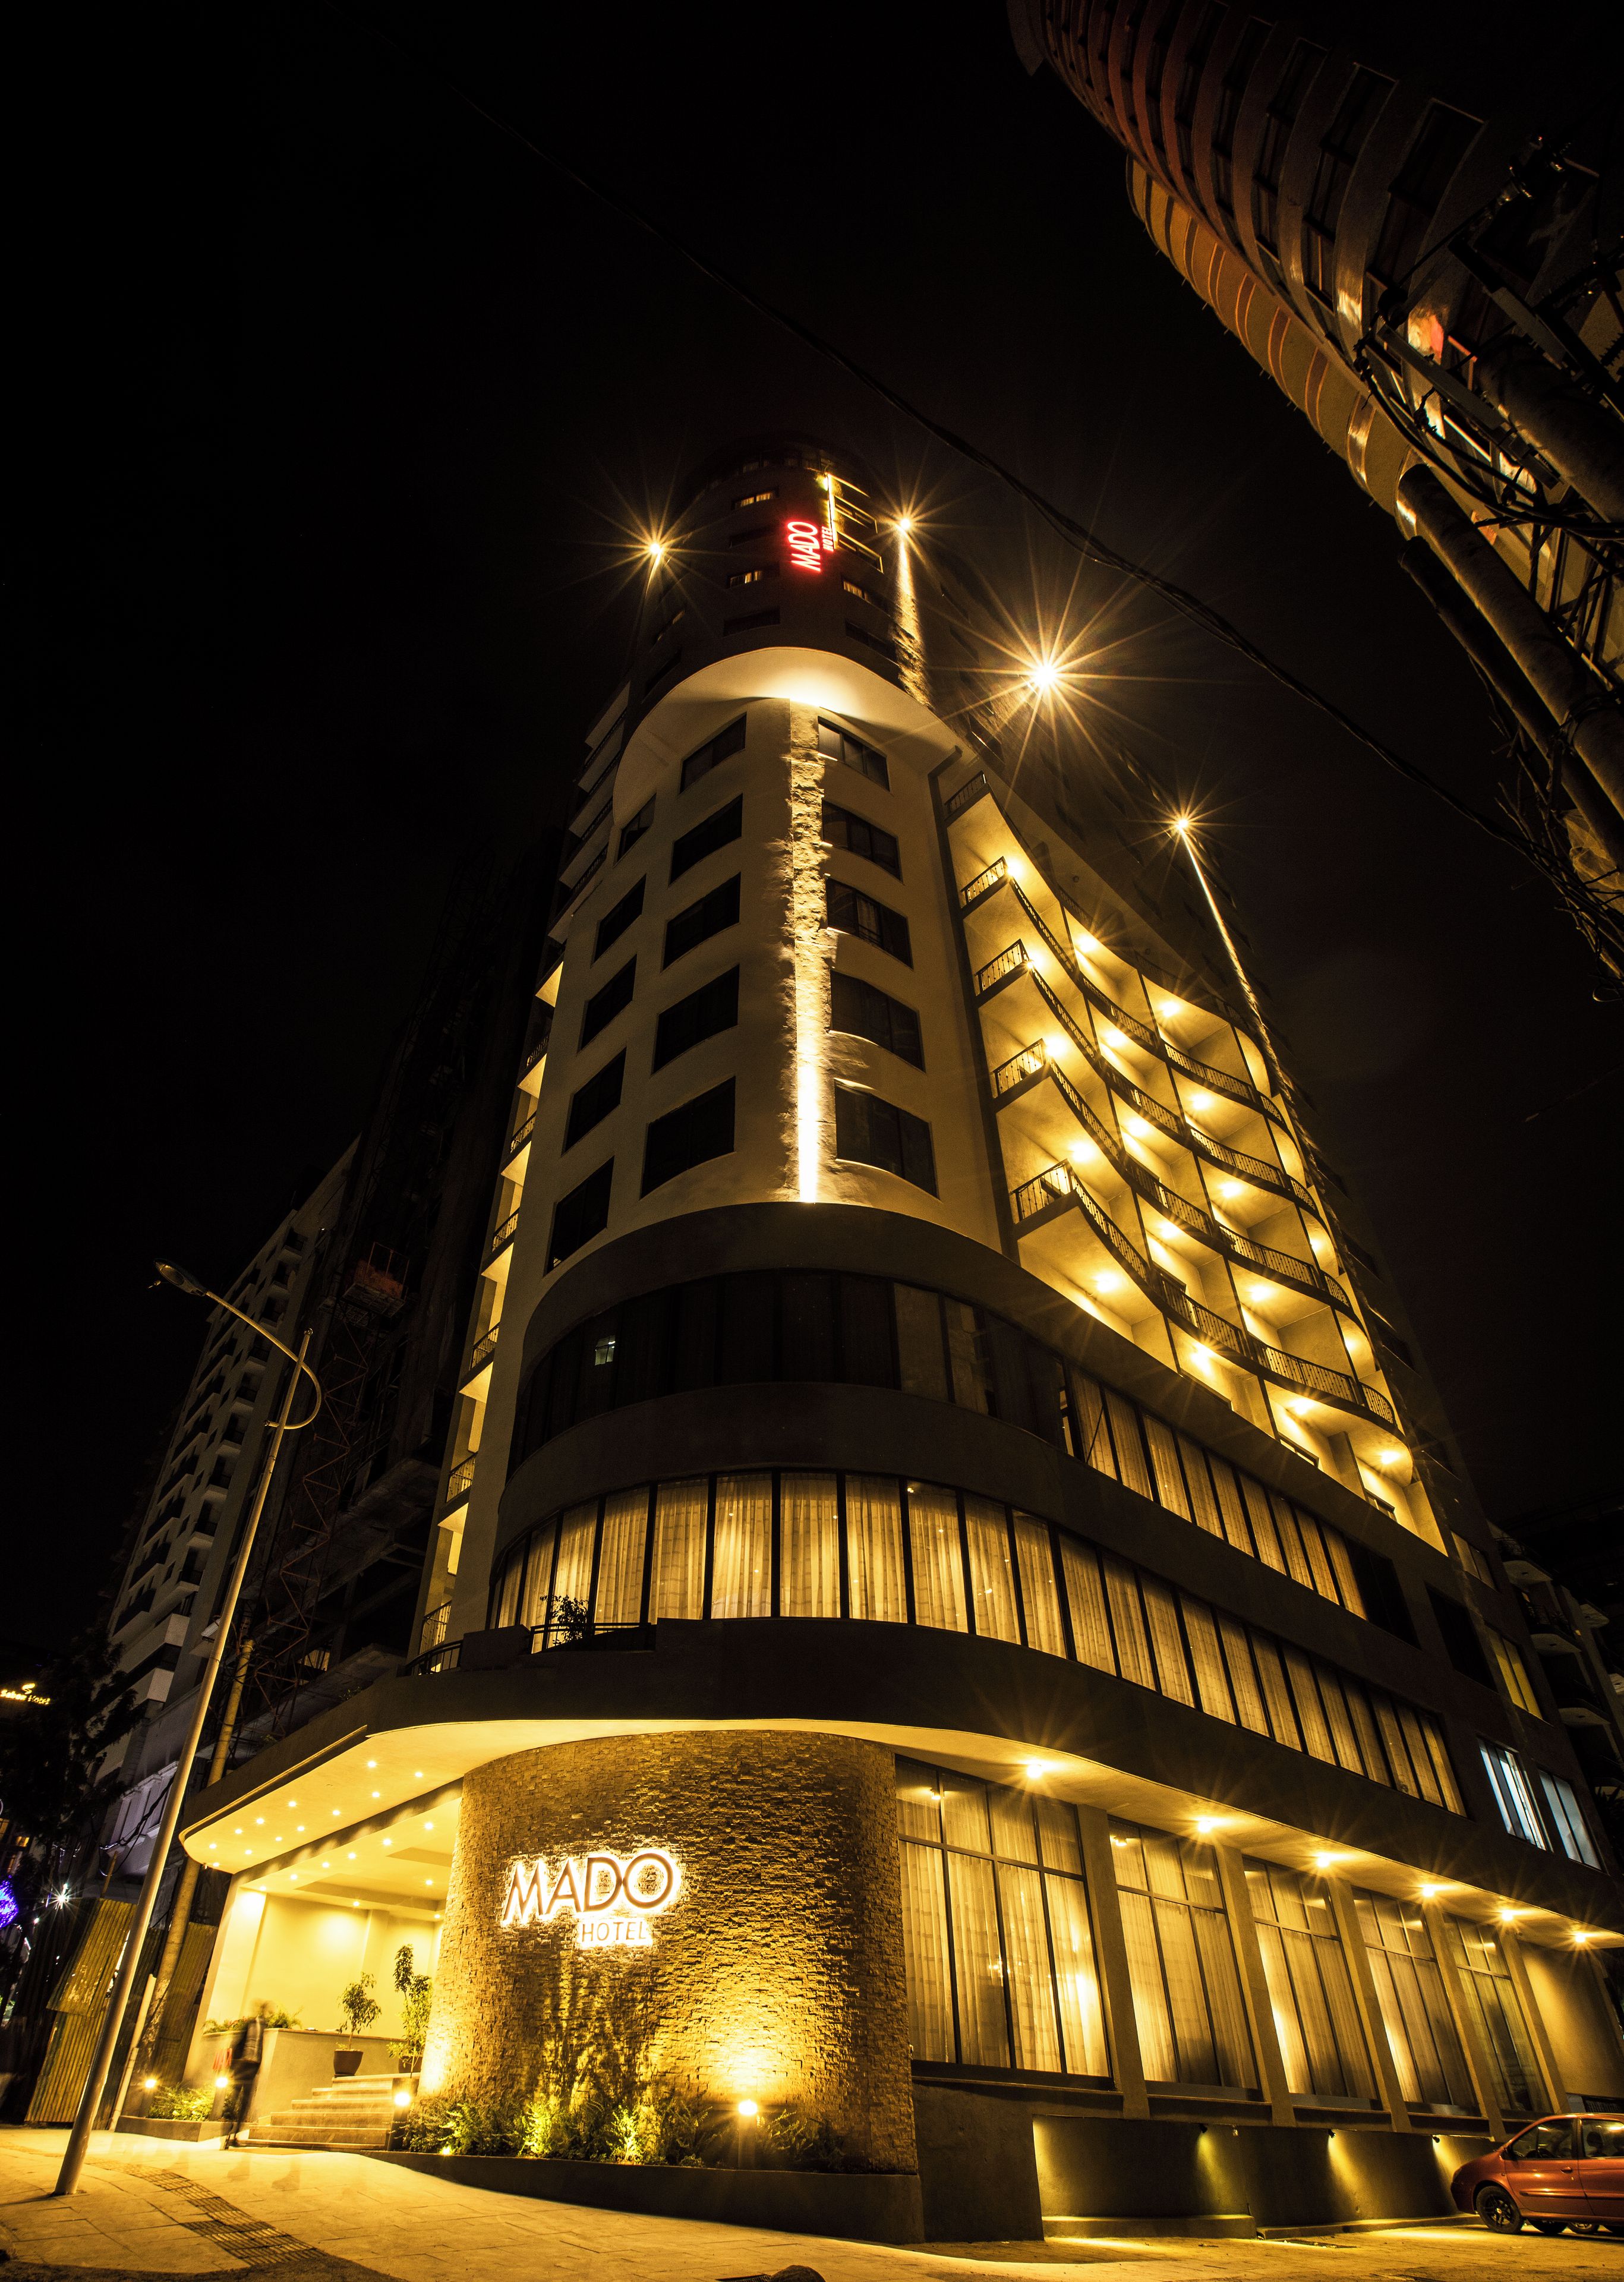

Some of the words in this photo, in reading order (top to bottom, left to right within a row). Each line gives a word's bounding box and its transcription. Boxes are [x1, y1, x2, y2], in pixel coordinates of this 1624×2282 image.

[787, 521, 821, 572] MADO
[821, 526, 834, 552] HOTEL
[504, 1853, 673, 1920] MADO
[582, 1921, 647, 1941] HOTEL
